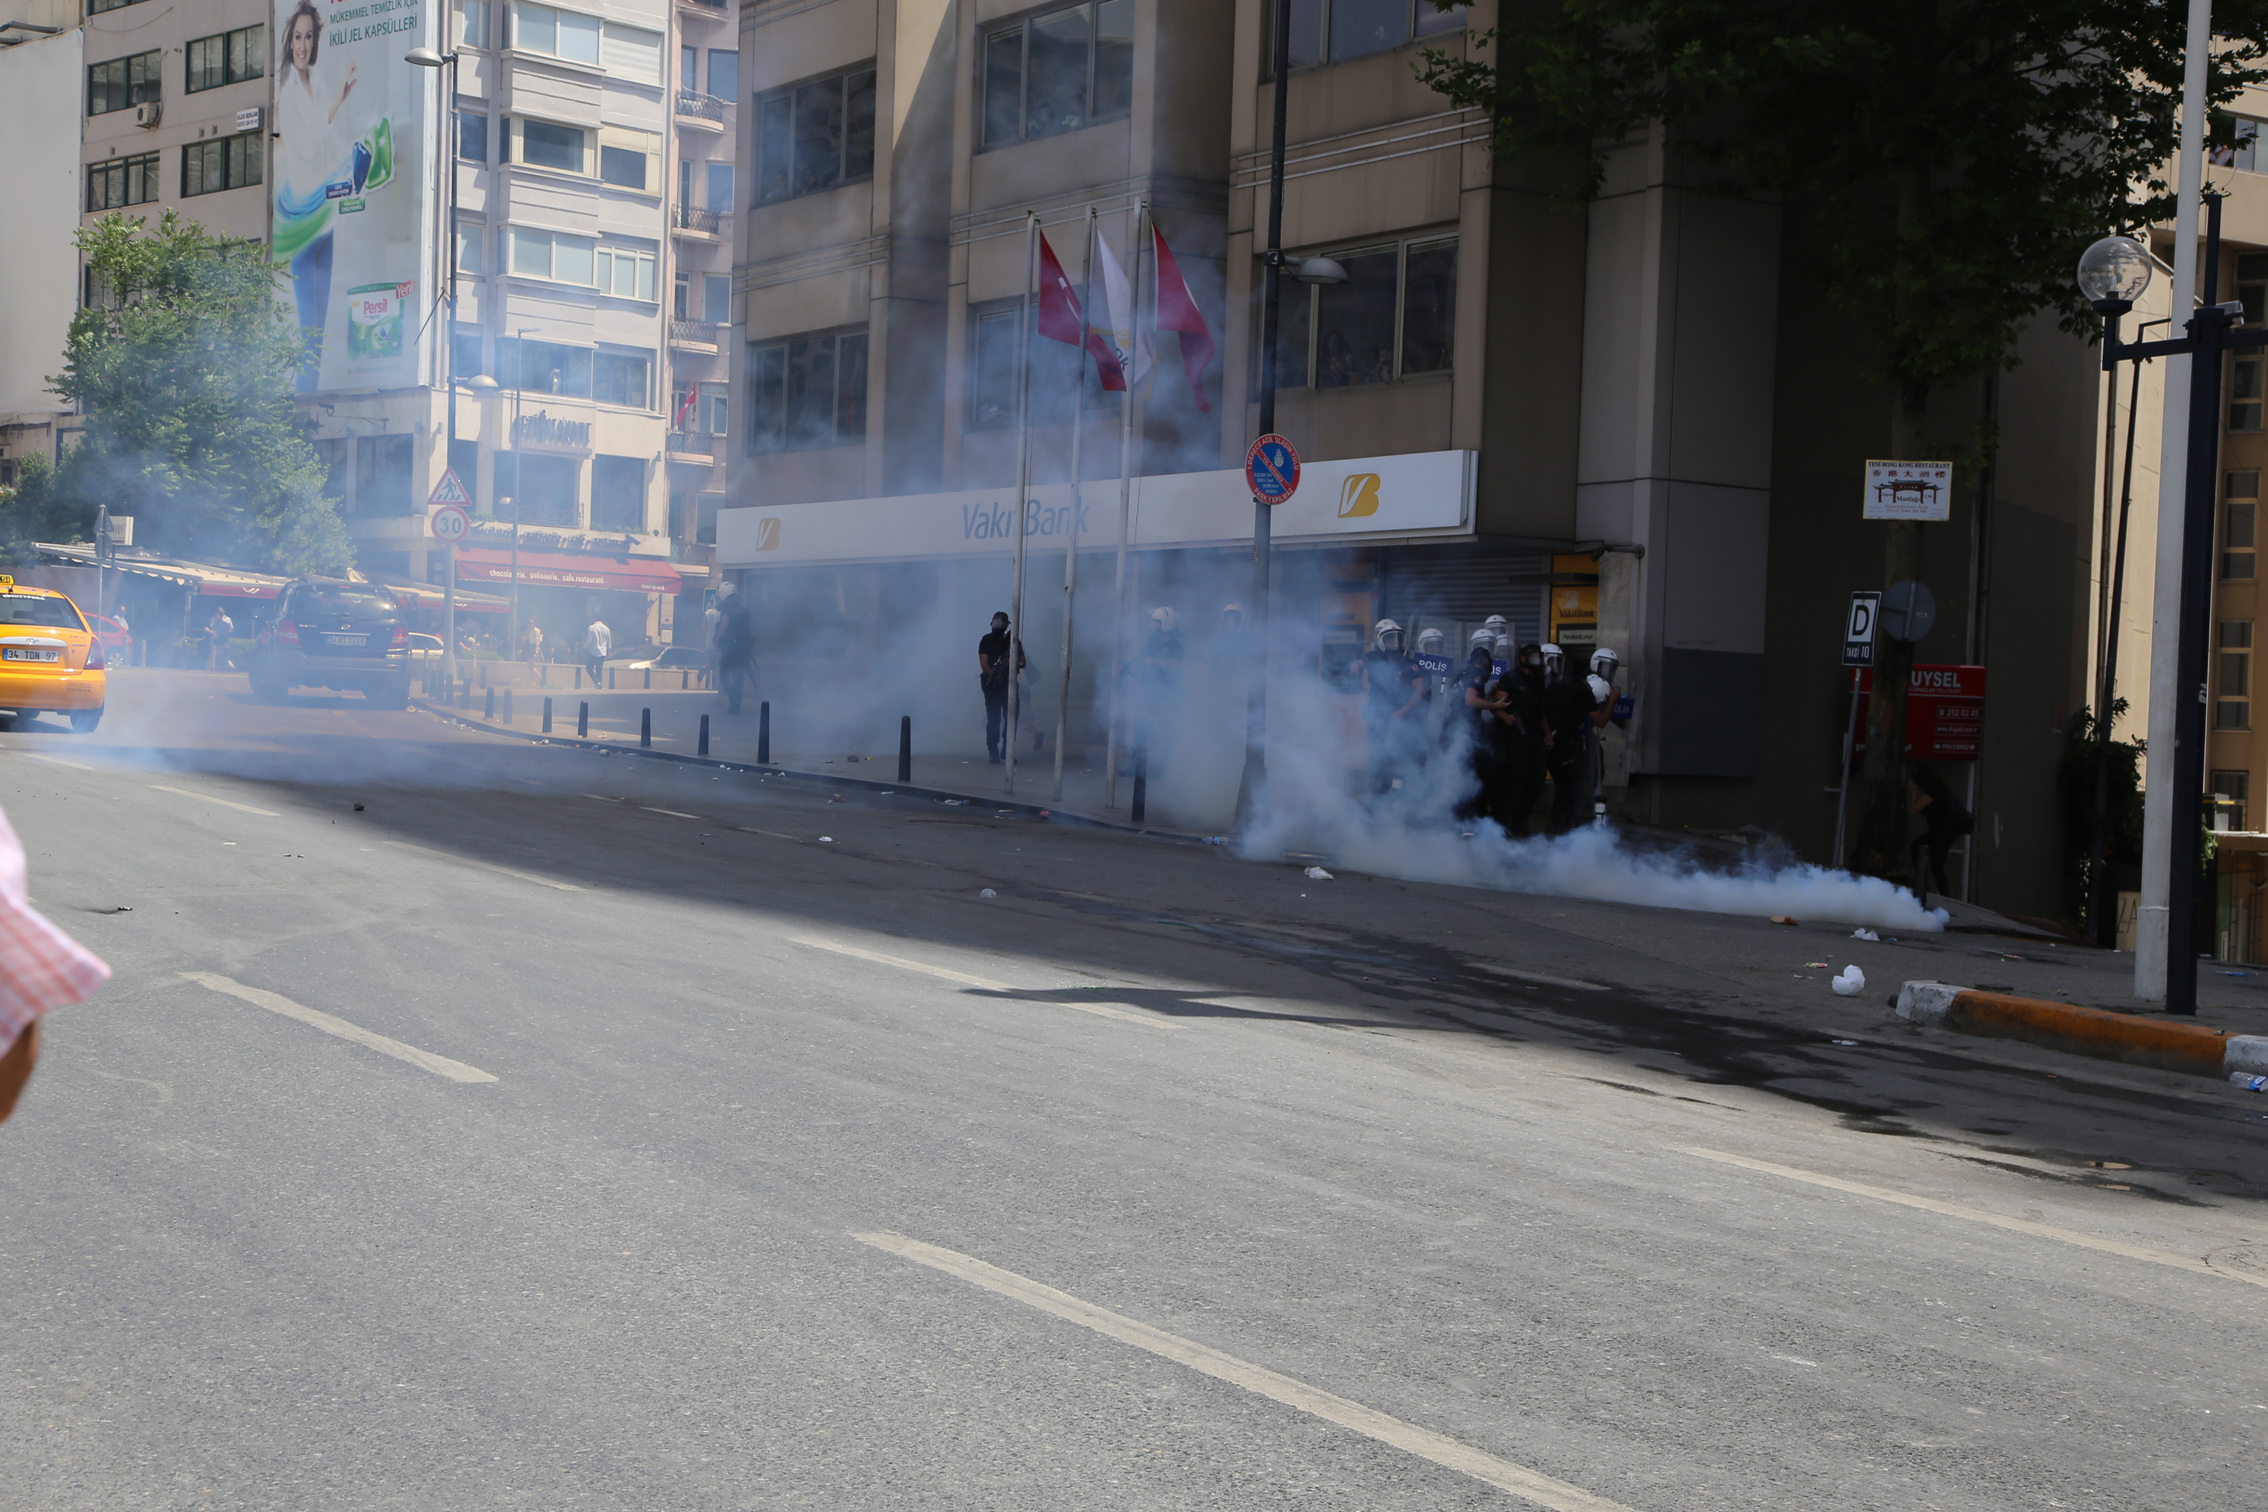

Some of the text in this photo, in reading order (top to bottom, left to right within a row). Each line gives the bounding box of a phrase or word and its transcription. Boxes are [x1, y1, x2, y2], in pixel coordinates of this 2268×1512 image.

[330, 6, 369, 24] MÜKEMMEL
[329, 13, 417, 47] İKİLİ JEL KAPSÜLLERİ
[396, 280, 414, 298] Yeni
[364, 298, 387, 315] Persil
[1291, 453, 1299, 470] YOLU
[1254, 487, 1267, 502] PARK
[440, 517, 461, 534] 30
[1852, 605, 1870, 636] D
[8, 650, 19, 659] 34
[46, 652, 56, 661] 97
[1846, 646, 1870, 658] TAKSİ 10
[1419, 660, 1447, 672] POLİS
[1911, 671, 1961, 688] UYSEL
[1614, 704, 1630, 713] OLİS
